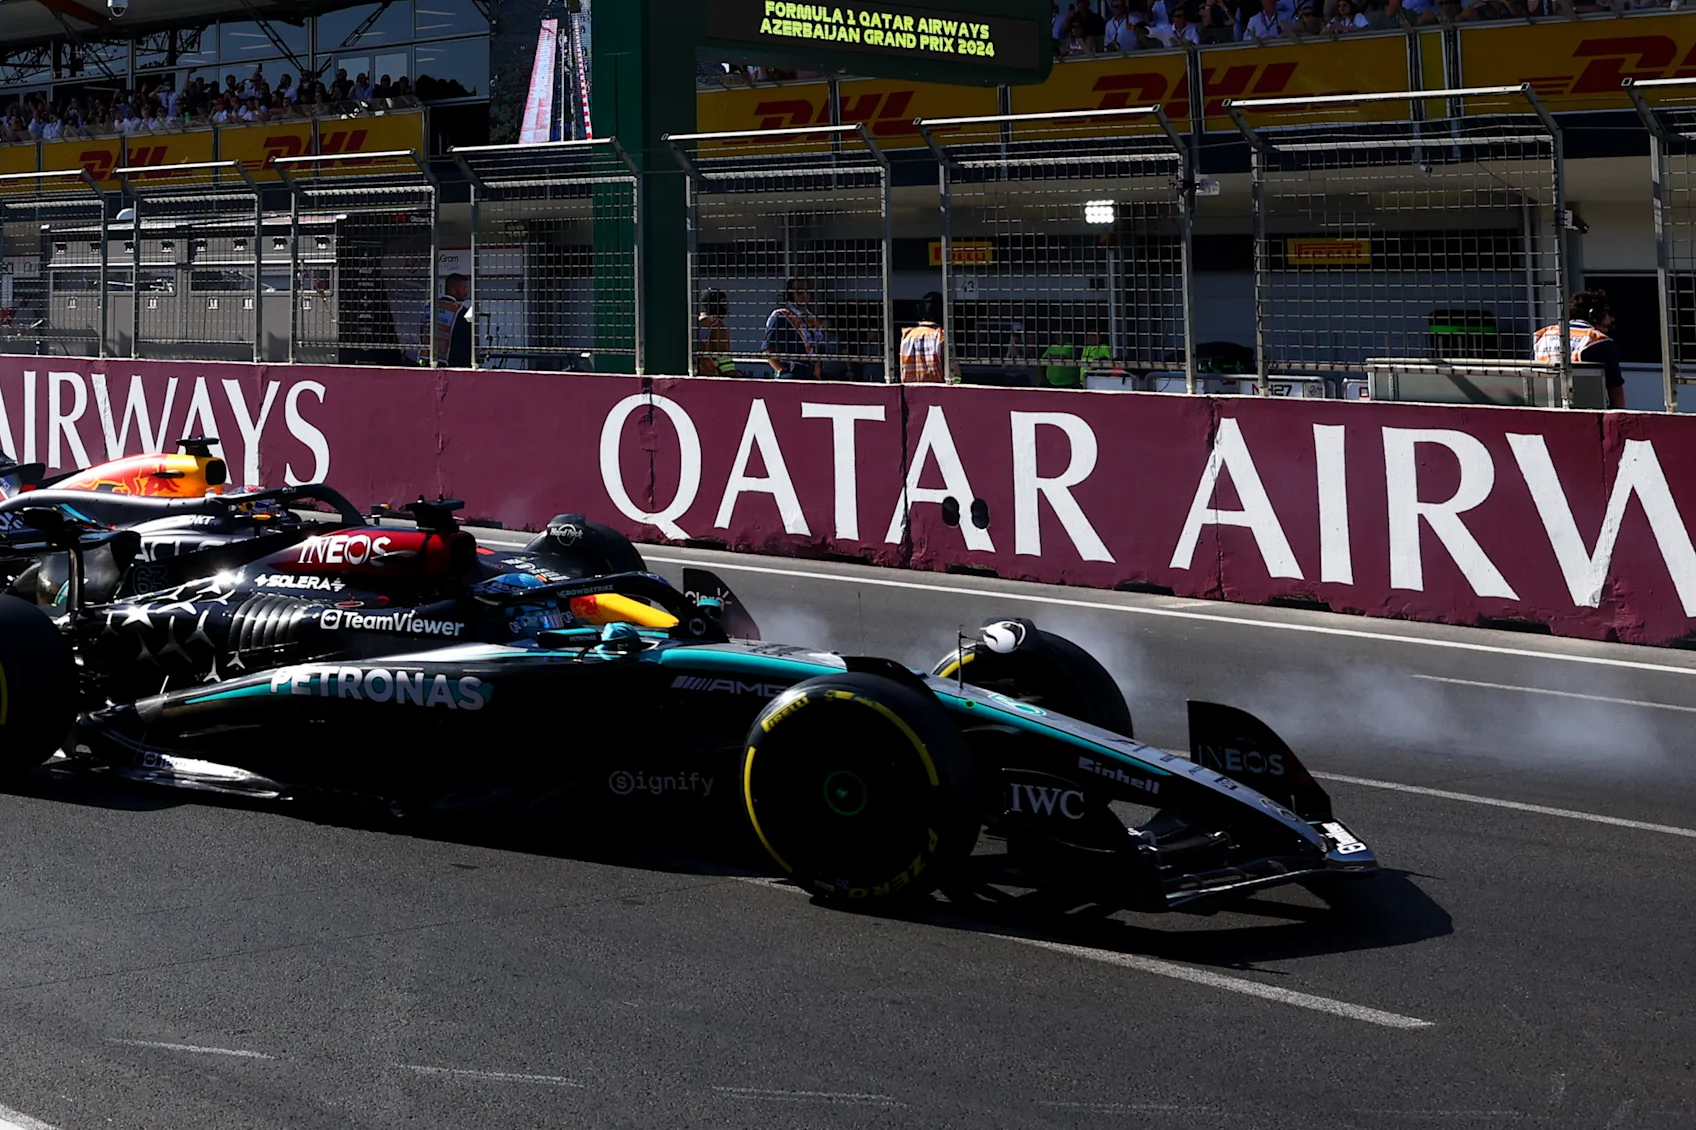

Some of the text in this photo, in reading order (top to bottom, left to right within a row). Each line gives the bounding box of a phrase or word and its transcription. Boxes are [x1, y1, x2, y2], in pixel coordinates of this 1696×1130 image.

[760, 18, 995, 57] AZERBAIJAN GRAND PRIX 2024
[765, 0, 990, 40] FORMULA 1 QATAR AIRWAYS
[1090, 62, 1299, 121] DHL
[749, 91, 915, 143] DHL
[76, 146, 168, 181] DHL
[260, 130, 368, 170] DHL
[934, 247, 986, 261] PRELLI
[599, 393, 1116, 564] QATAR
[298, 535, 391, 566] INEOS
[266, 575, 332, 591] SOLERA
[343, 609, 465, 636] TeamViewer
[270, 665, 484, 711] PETRONAS
[712, 678, 789, 698] AMG
[1077, 756, 1161, 796] Einhell
[1197, 744, 1285, 776] INEOS
[1010, 782, 1085, 820] IWC
